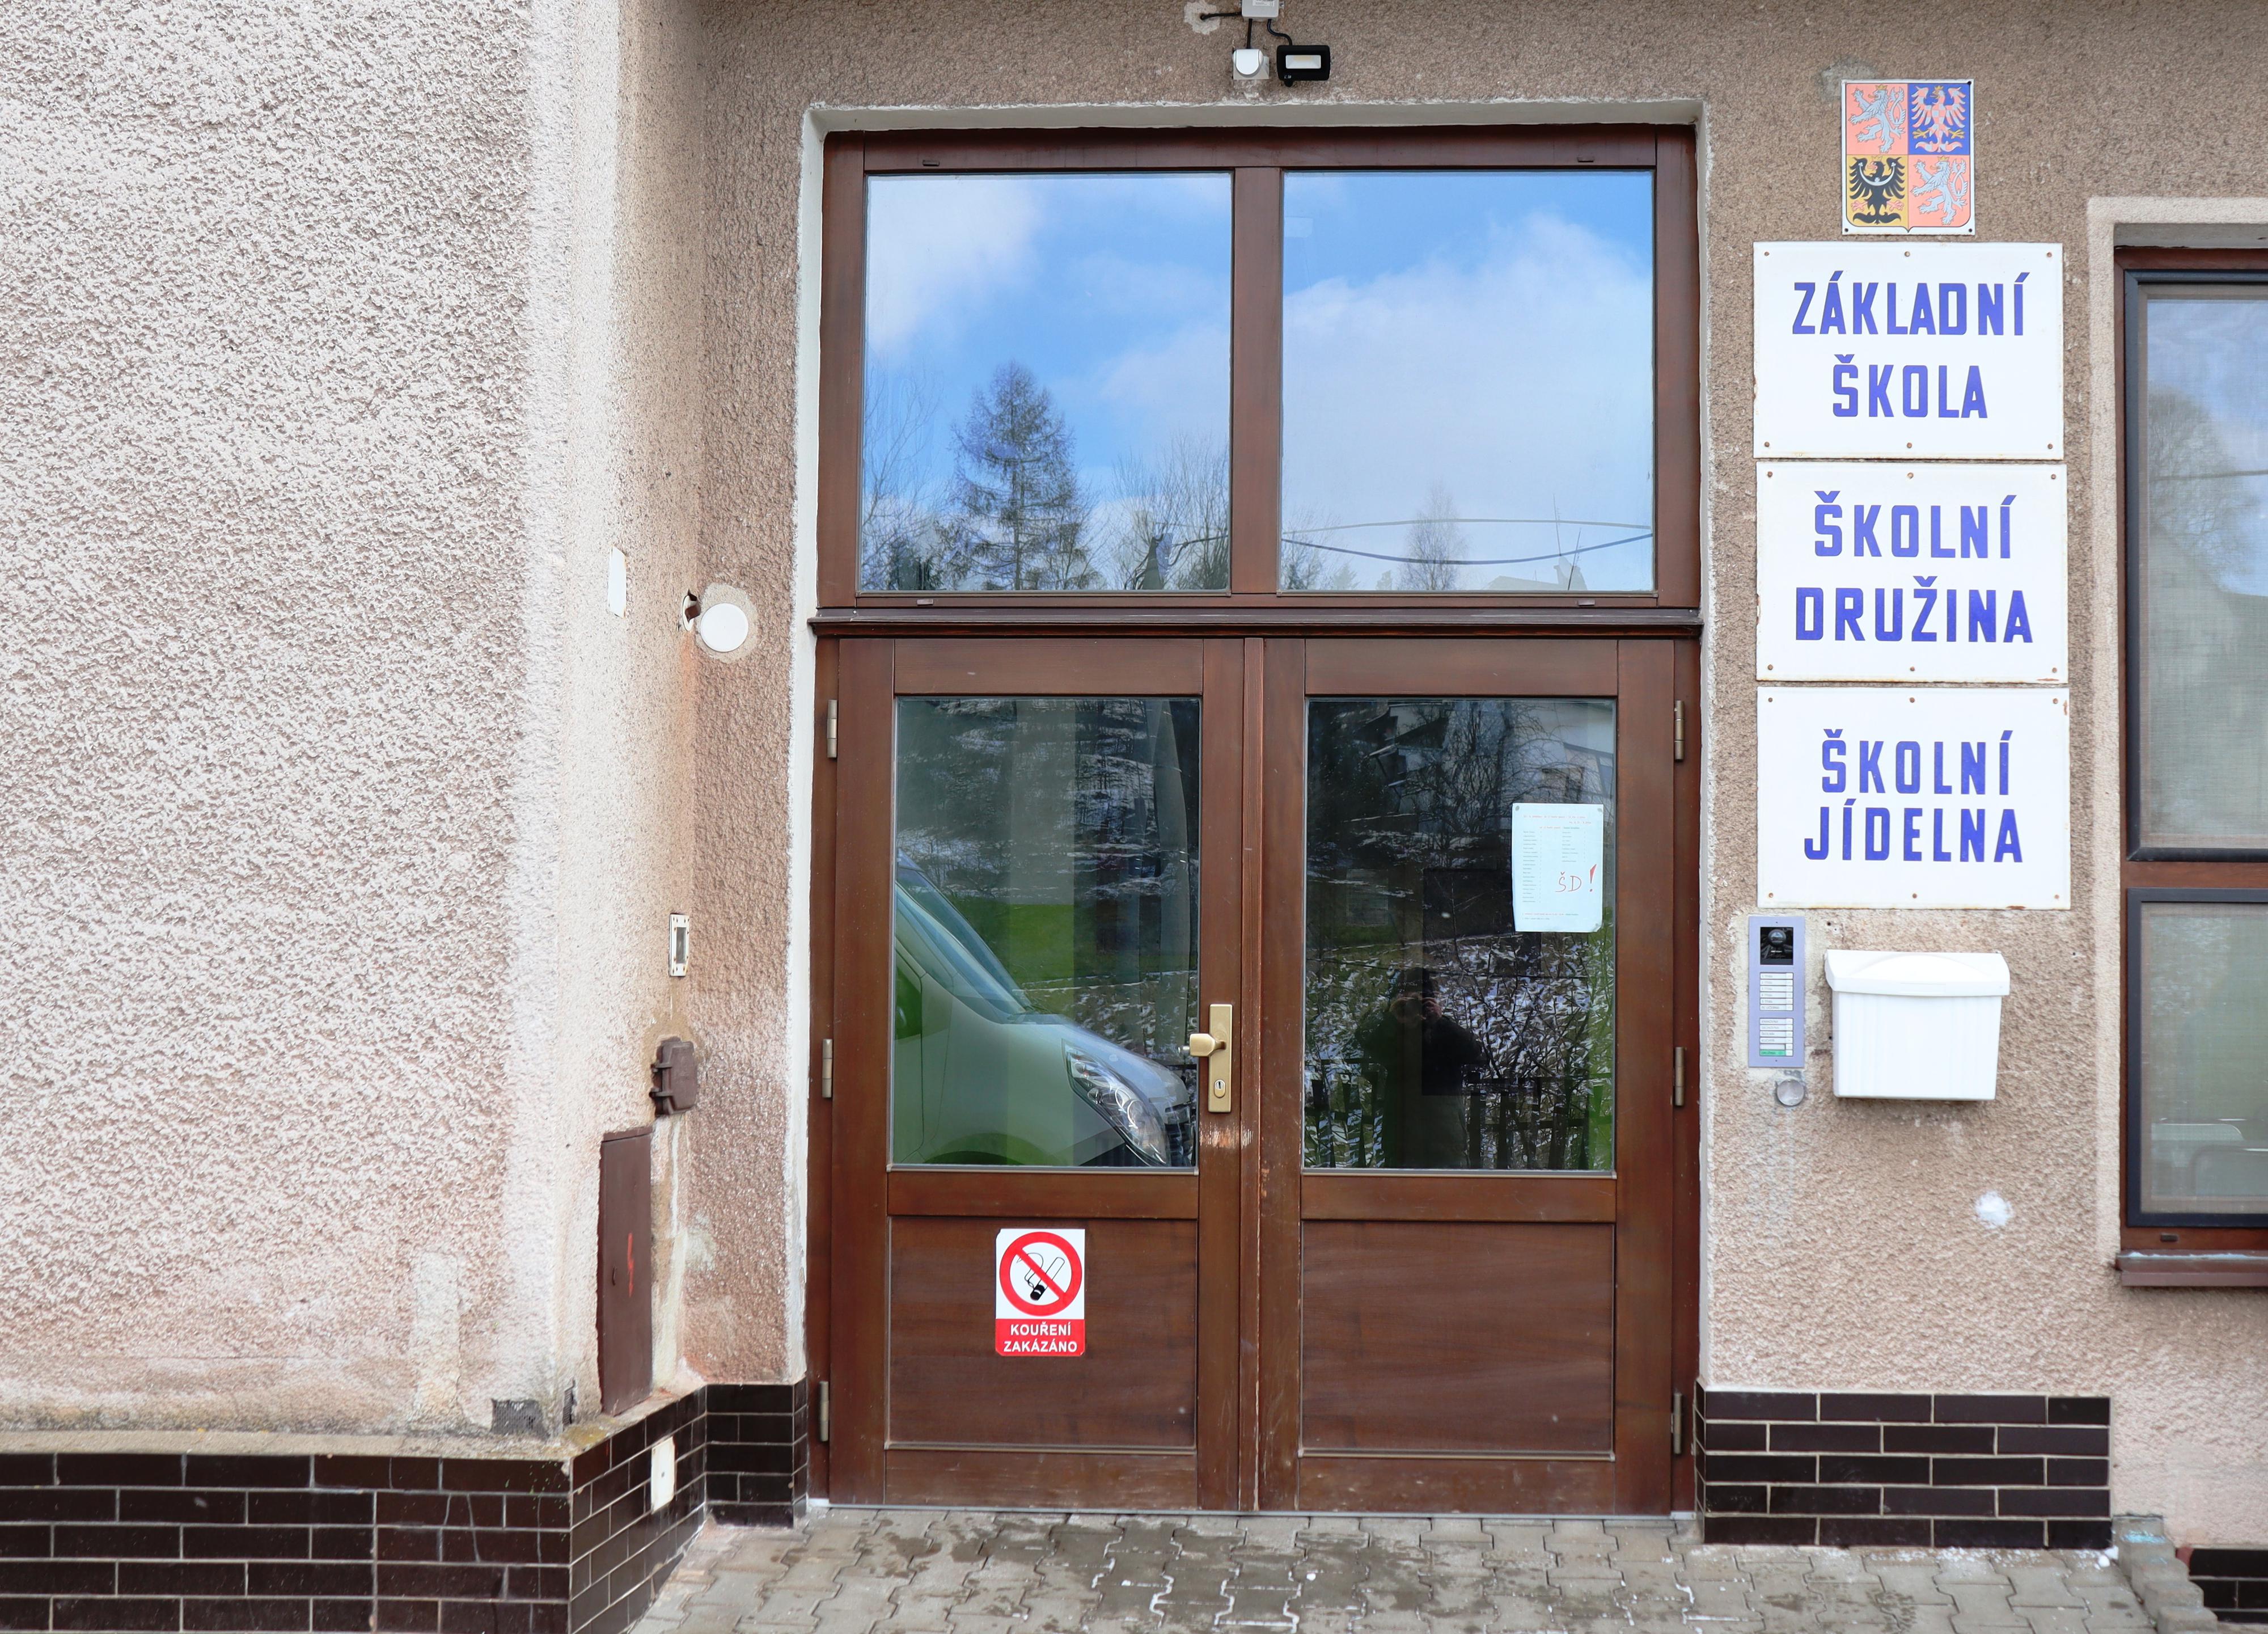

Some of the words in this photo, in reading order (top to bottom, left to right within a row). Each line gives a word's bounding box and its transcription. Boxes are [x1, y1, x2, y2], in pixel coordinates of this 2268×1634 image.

[1792, 271, 2029, 336] ZÁKLADNÍ
[1833, 353, 1988, 419] ŠKOLA
[1815, 490, 2015, 559] ŠKOLNÍ
[1796, 575, 2033, 644] DRUŽINA
[1822, 728, 2013, 796] ŠKOLNÍ
[1804, 798, 2023, 863] JÍDELNA
[1004, 1338, 1077, 1352] ZAKÁZÁNO
[1010, 1321, 1071, 1335] KOUŘENÍ
